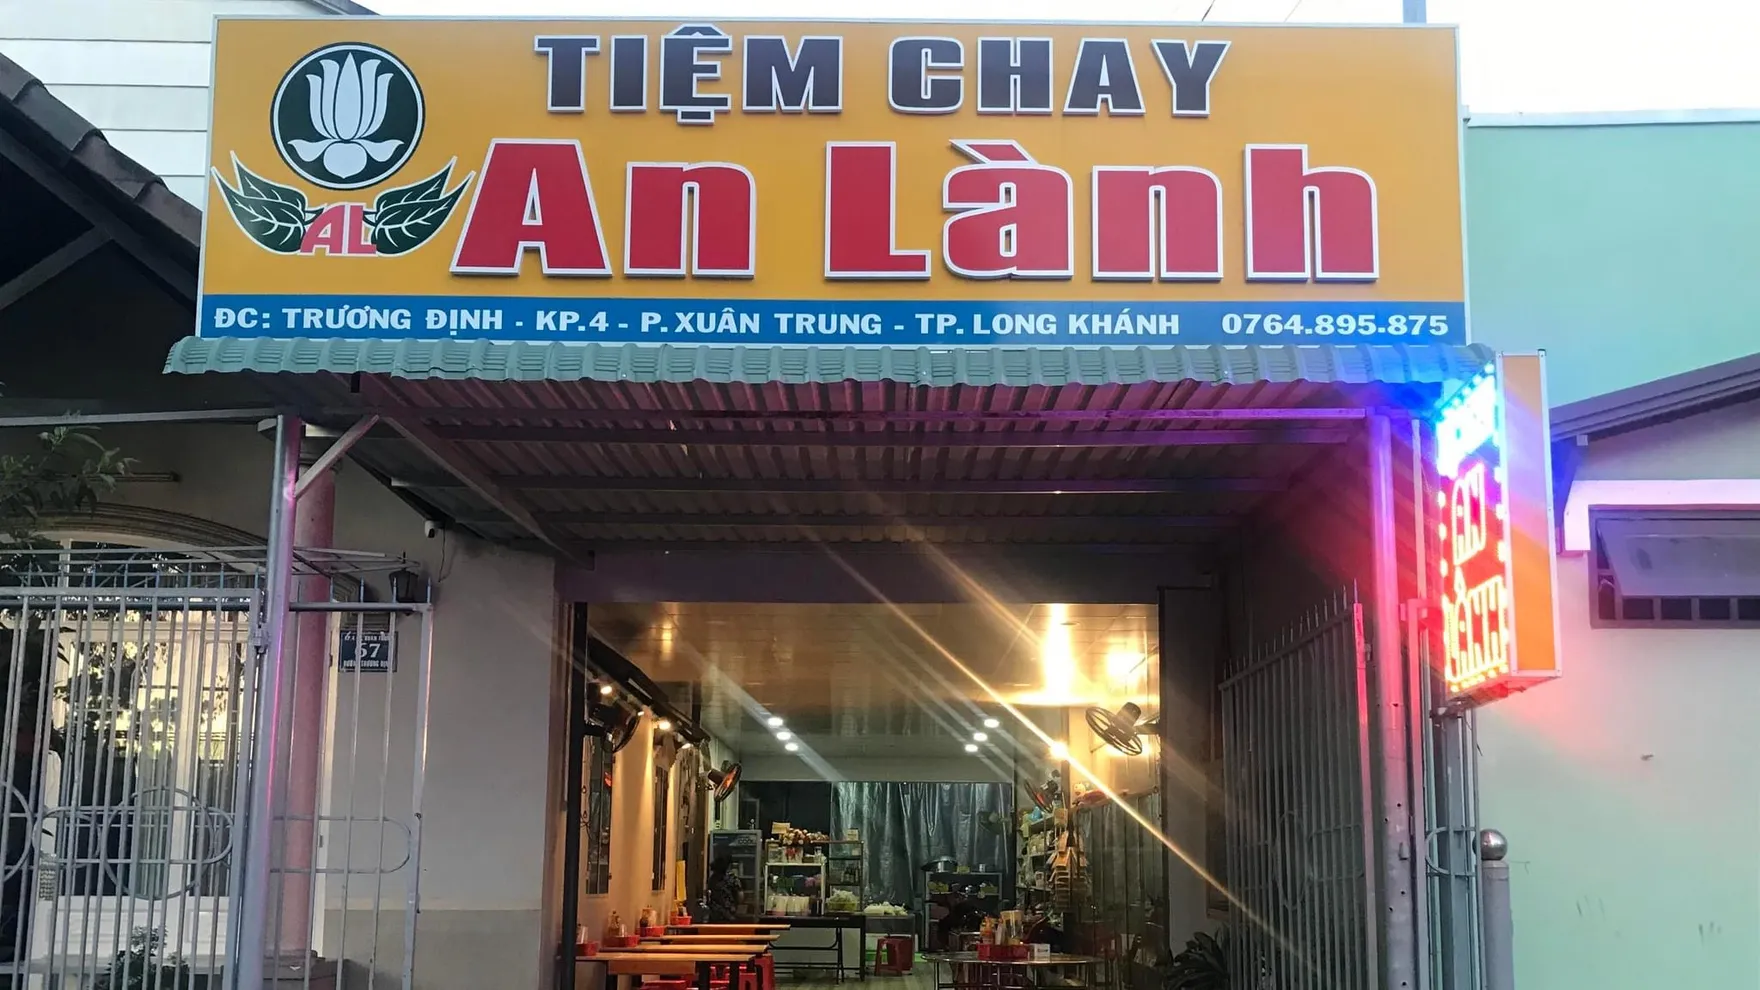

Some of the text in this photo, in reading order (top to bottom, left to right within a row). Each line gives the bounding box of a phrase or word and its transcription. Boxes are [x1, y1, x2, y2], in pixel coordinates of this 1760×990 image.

[534, 24, 1232, 125] TIỆM CHAY
[298, 202, 377, 256] AL
[449, 138, 1379, 282] An Lành
[214, 307, 270, 329] ĐC:
[282, 304, 411, 330] TRƯƠNG
[425, 308, 503, 336] ĐỊNH
[536, 310, 609, 332] KP.4
[774, 313, 882, 335] TRUNG
[915, 313, 964, 335] TP.
[973, 313, 1058, 335] LONG
[1068, 308, 1180, 335] KHÁNH
[1221, 313, 1449, 336] 0764.895.875
